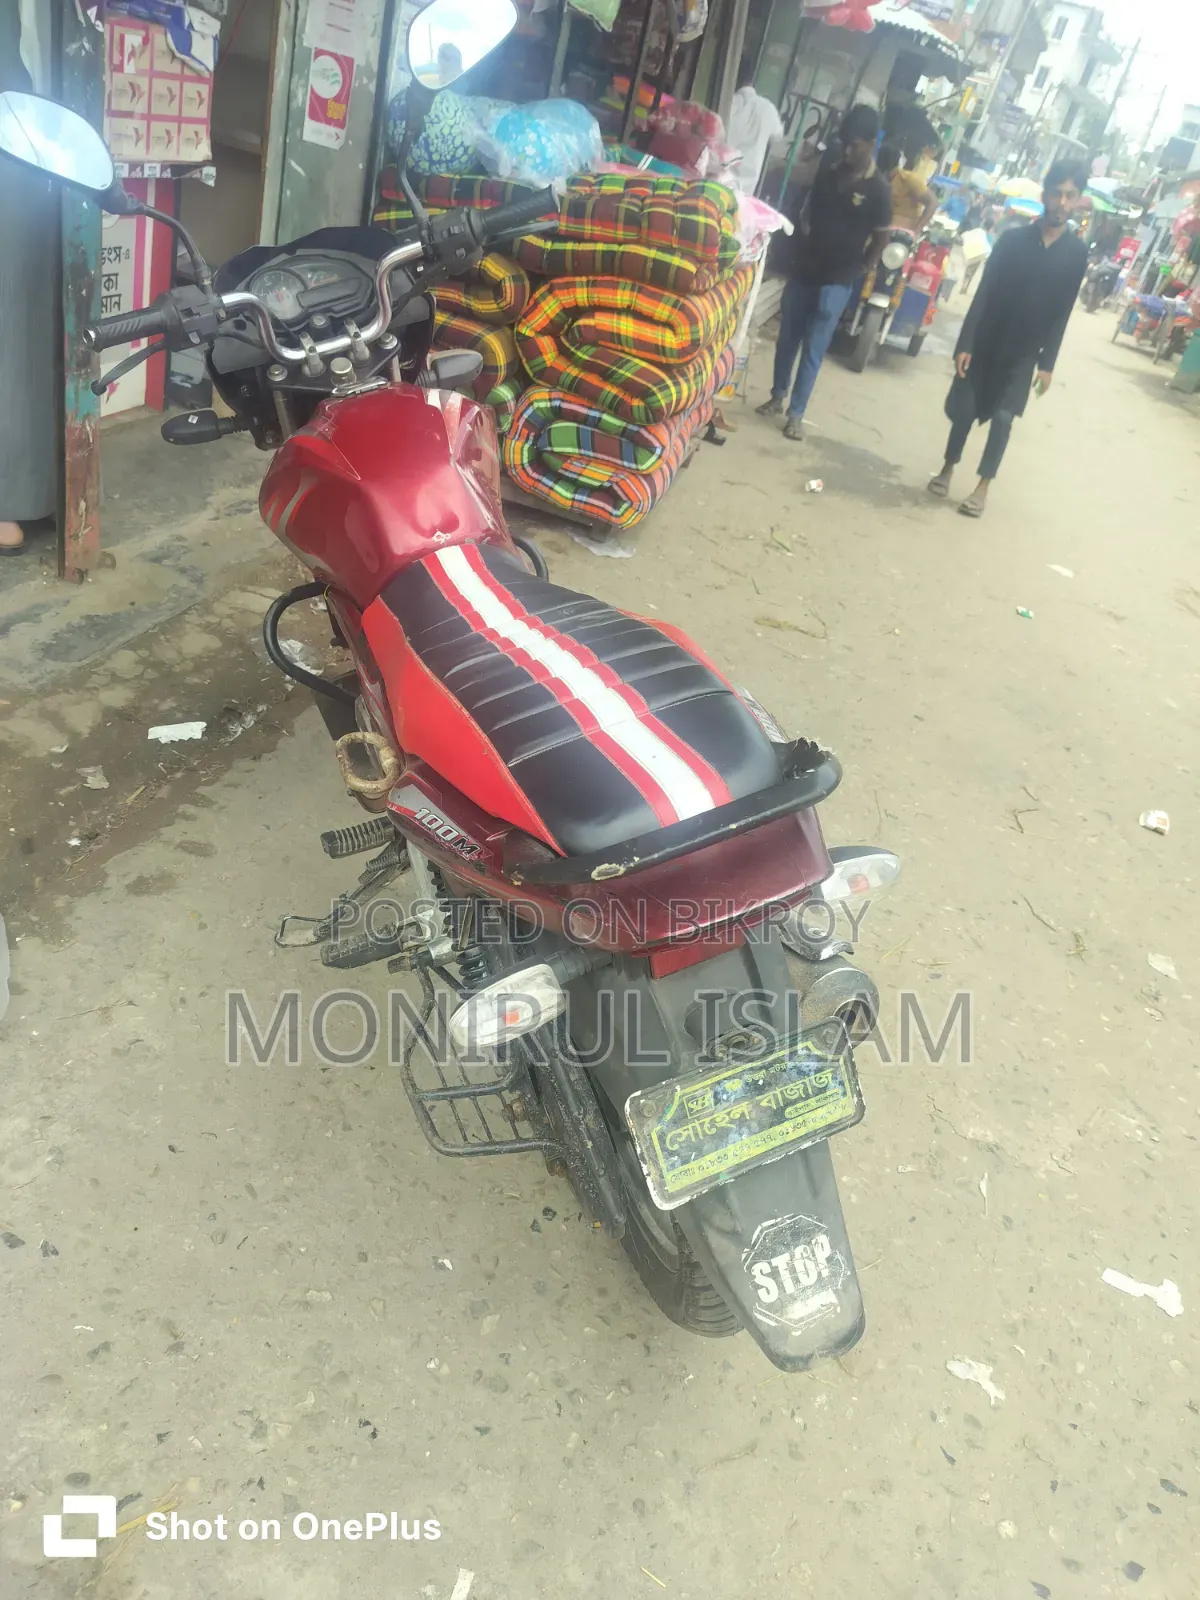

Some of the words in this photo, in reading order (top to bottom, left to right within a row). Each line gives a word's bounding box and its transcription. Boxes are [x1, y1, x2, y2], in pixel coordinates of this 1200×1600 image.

[666, 1100, 752, 1151] সোহেল
[757, 1067, 836, 1111] বাজাজ
[750, 1233, 832, 1303] STOP
